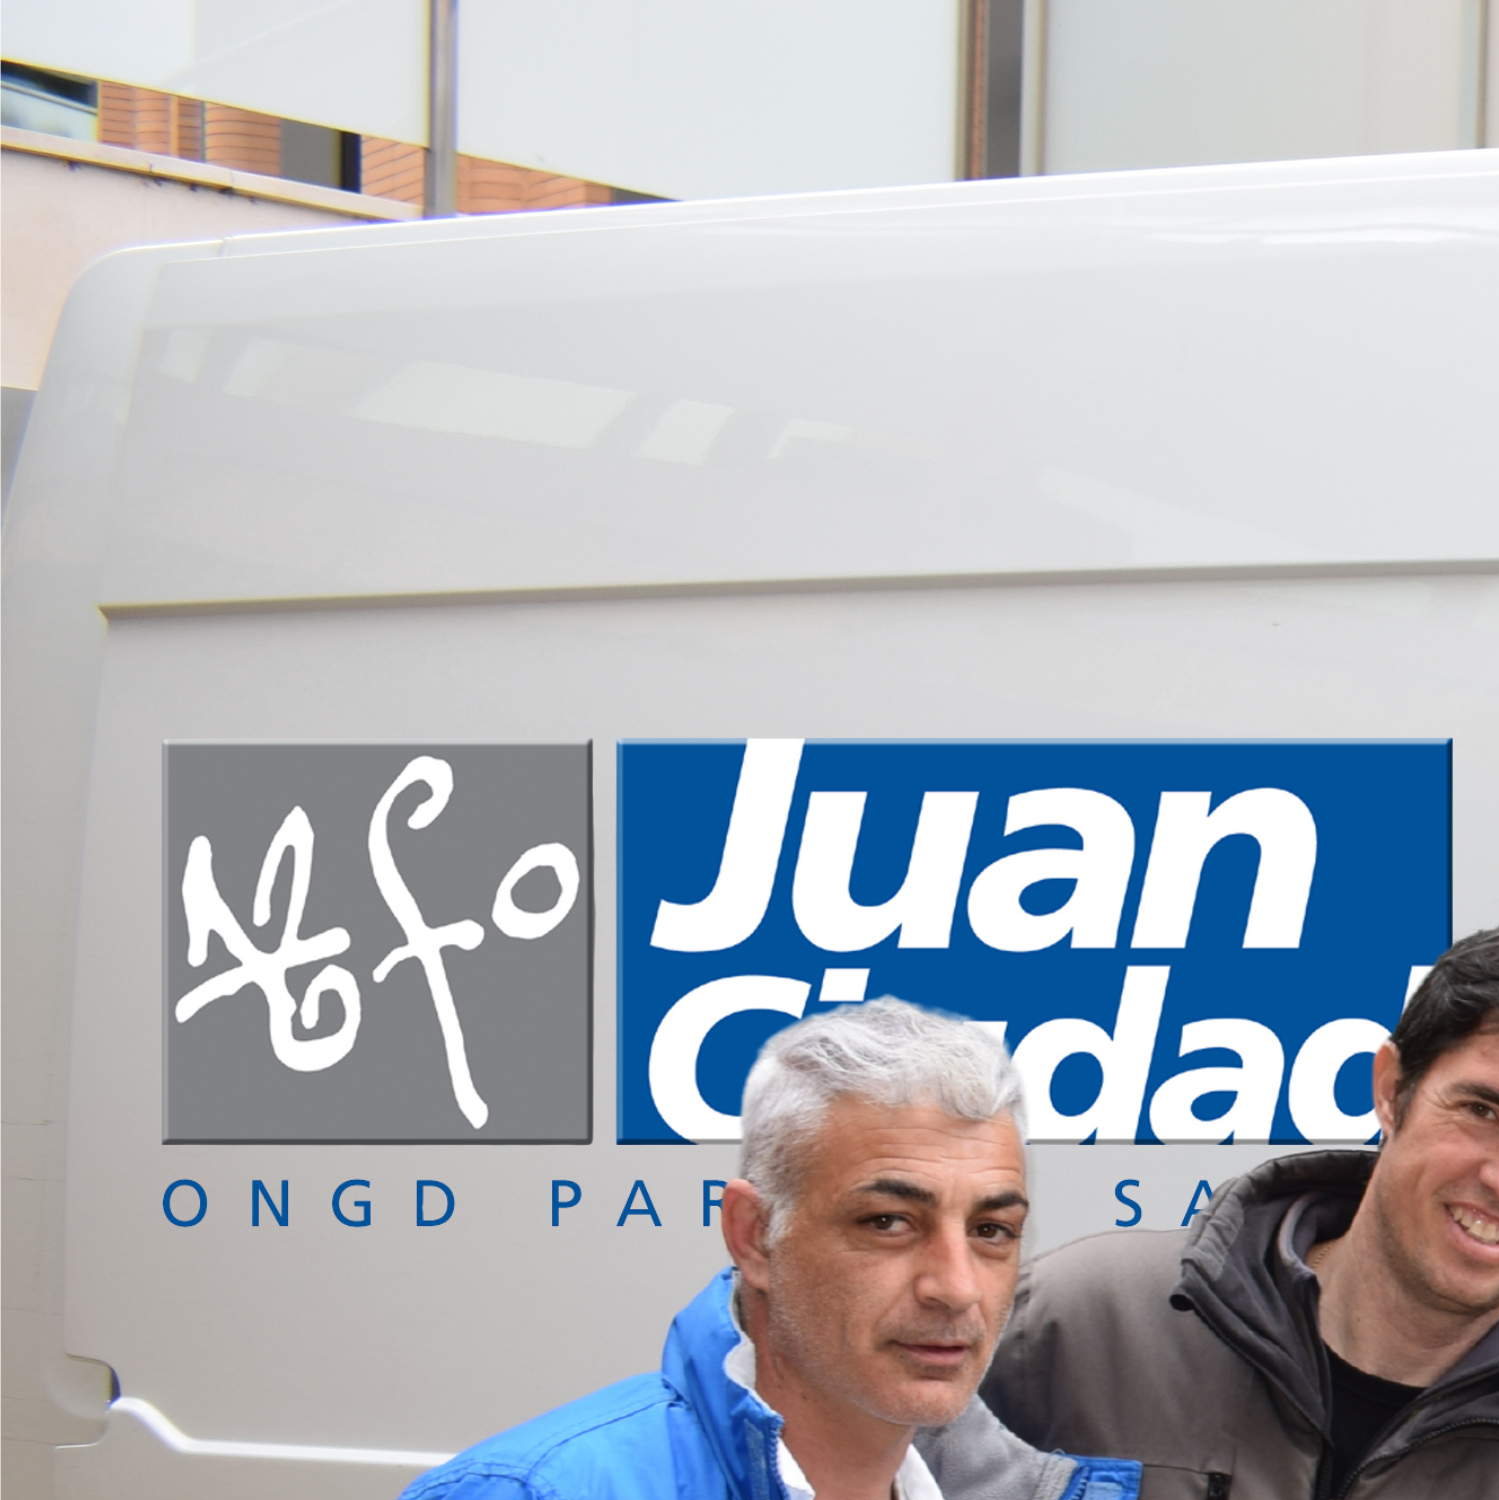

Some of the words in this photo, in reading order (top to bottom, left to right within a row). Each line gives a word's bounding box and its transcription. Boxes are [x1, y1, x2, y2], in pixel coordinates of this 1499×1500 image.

[649, 738, 1317, 952] Juan
[649, 965, 1437, 1145] Cdad
[162, 1178, 459, 1229] ONGD
[551, 1178, 728, 1229] PAR
